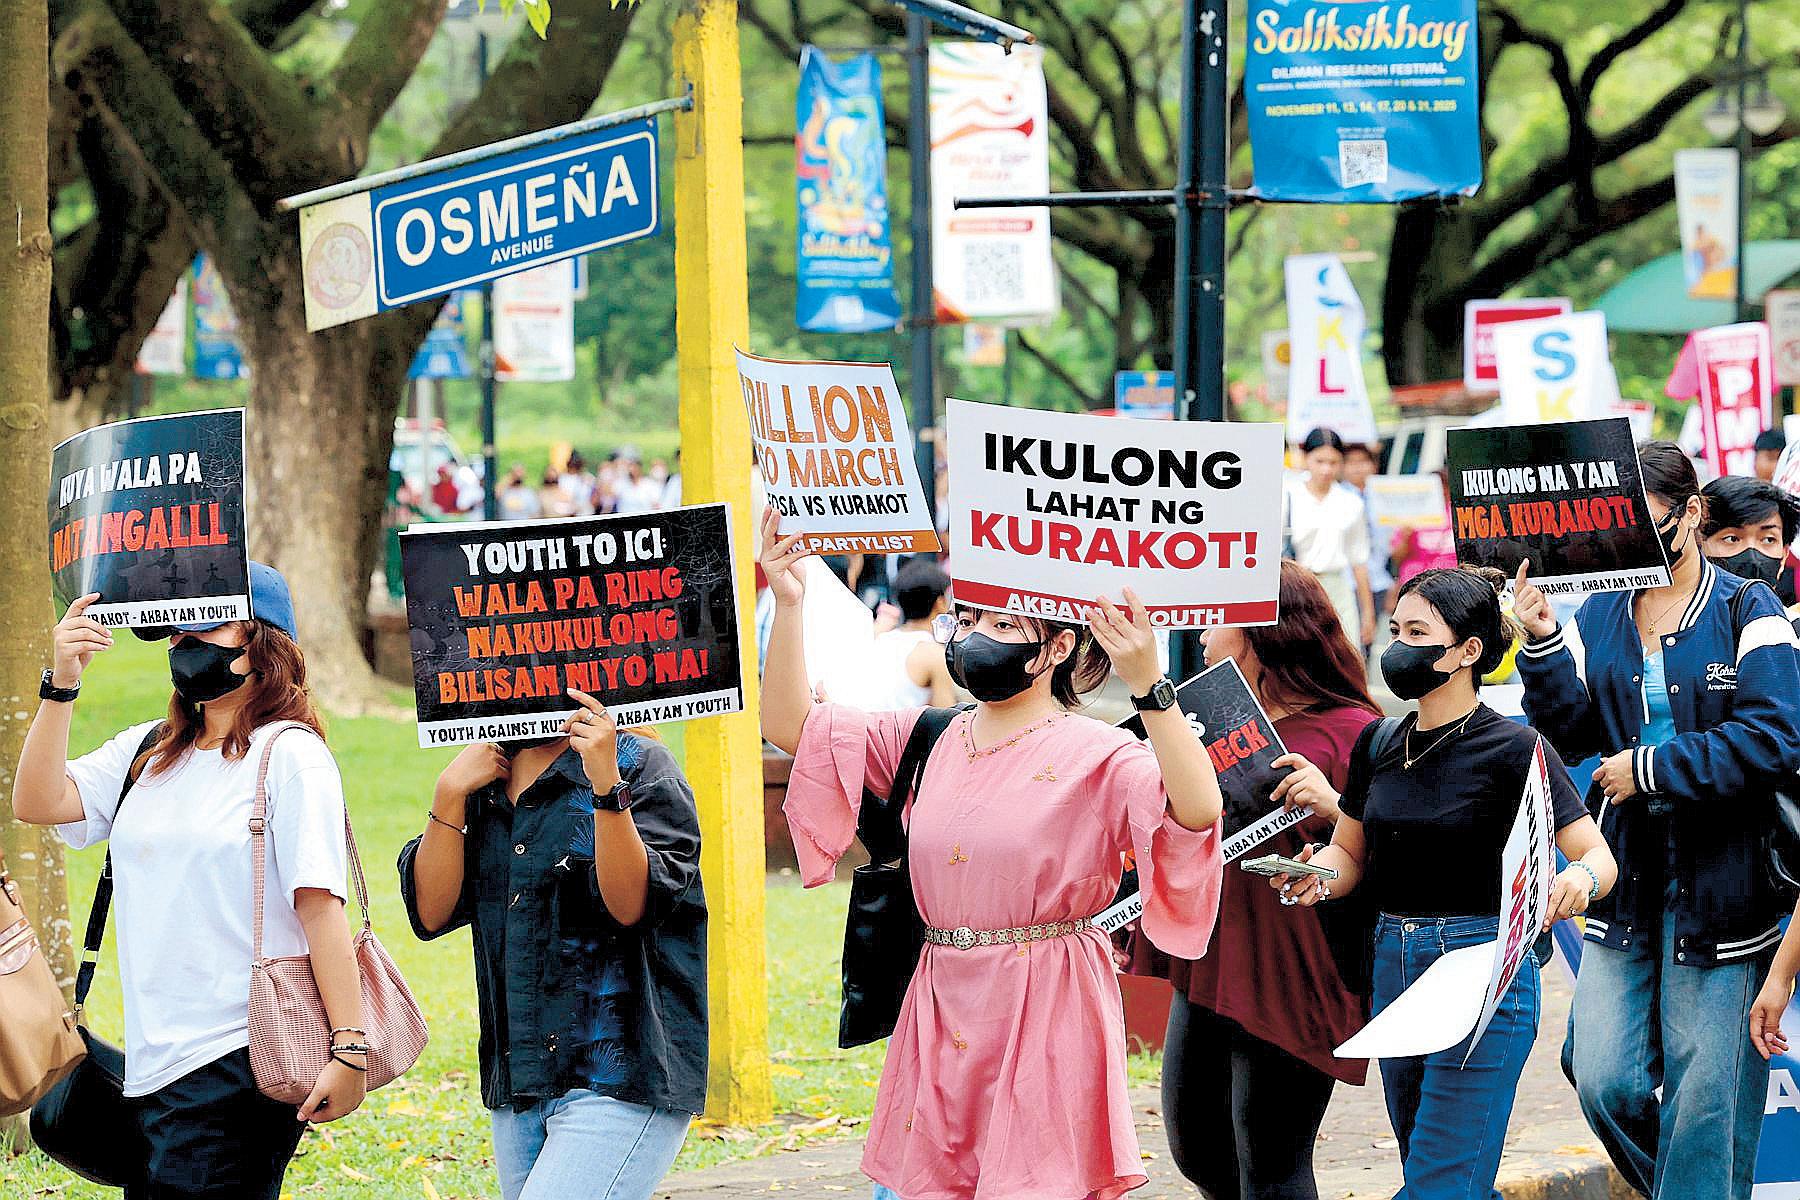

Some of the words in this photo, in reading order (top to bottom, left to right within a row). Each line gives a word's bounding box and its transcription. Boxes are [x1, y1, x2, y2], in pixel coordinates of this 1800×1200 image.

[1253, 4, 1470, 62] Saliksikhay
[395, 154, 639, 267] OSMEÑA
[490, 234, 554, 265] AVENUE
[59, 466, 95, 509] KUYA
[100, 455, 163, 493] WALA
[168, 451, 203, 485] PA
[786, 447, 904, 488] MARCH
[984, 432, 1242, 490] IKULONG
[1461, 466, 1537, 497] IKULONG
[1538, 464, 1570, 492] NA
[1570, 460, 1620, 489] YAN
[802, 495, 826, 516] VS
[830, 493, 909, 516] KURAKOT
[1026, 487, 1141, 523] LAHAT
[1151, 499, 1204, 525] NG
[1455, 504, 1507, 539] MGA
[1508, 496, 1637, 538] KURAKOT!
[460, 536, 570, 577] YOUTH
[571, 532, 617, 568] TO
[624, 527, 668, 562] ICI:
[809, 535, 914, 552] PARTYLIST
[970, 509, 1258, 570] KURAKOT!
[453, 579, 551, 617] WALA
[553, 575, 599, 611] PA
[604, 565, 684, 609] RING
[1581, 577, 1626, 592] AKBAYAN
[1626, 574, 1661, 587] YOUTH
[140, 607, 196, 624] AKBAYAN
[199, 604, 238, 620] YOUTH
[1146, 607, 1225, 627] OUTH
[466, 609, 678, 659] NAKUKULONG
[437, 664, 560, 704] BILISAN
[565, 653, 648, 694] NIYO
[652, 648, 709, 686] NA!
[427, 724, 475, 743] YOUTH
[477, 719, 538, 740] AGAINST
[616, 705, 683, 727] AKBAYAN
[685, 697, 731, 717] YOUTH
[1222, 824, 1272, 860] AKBAYAN
